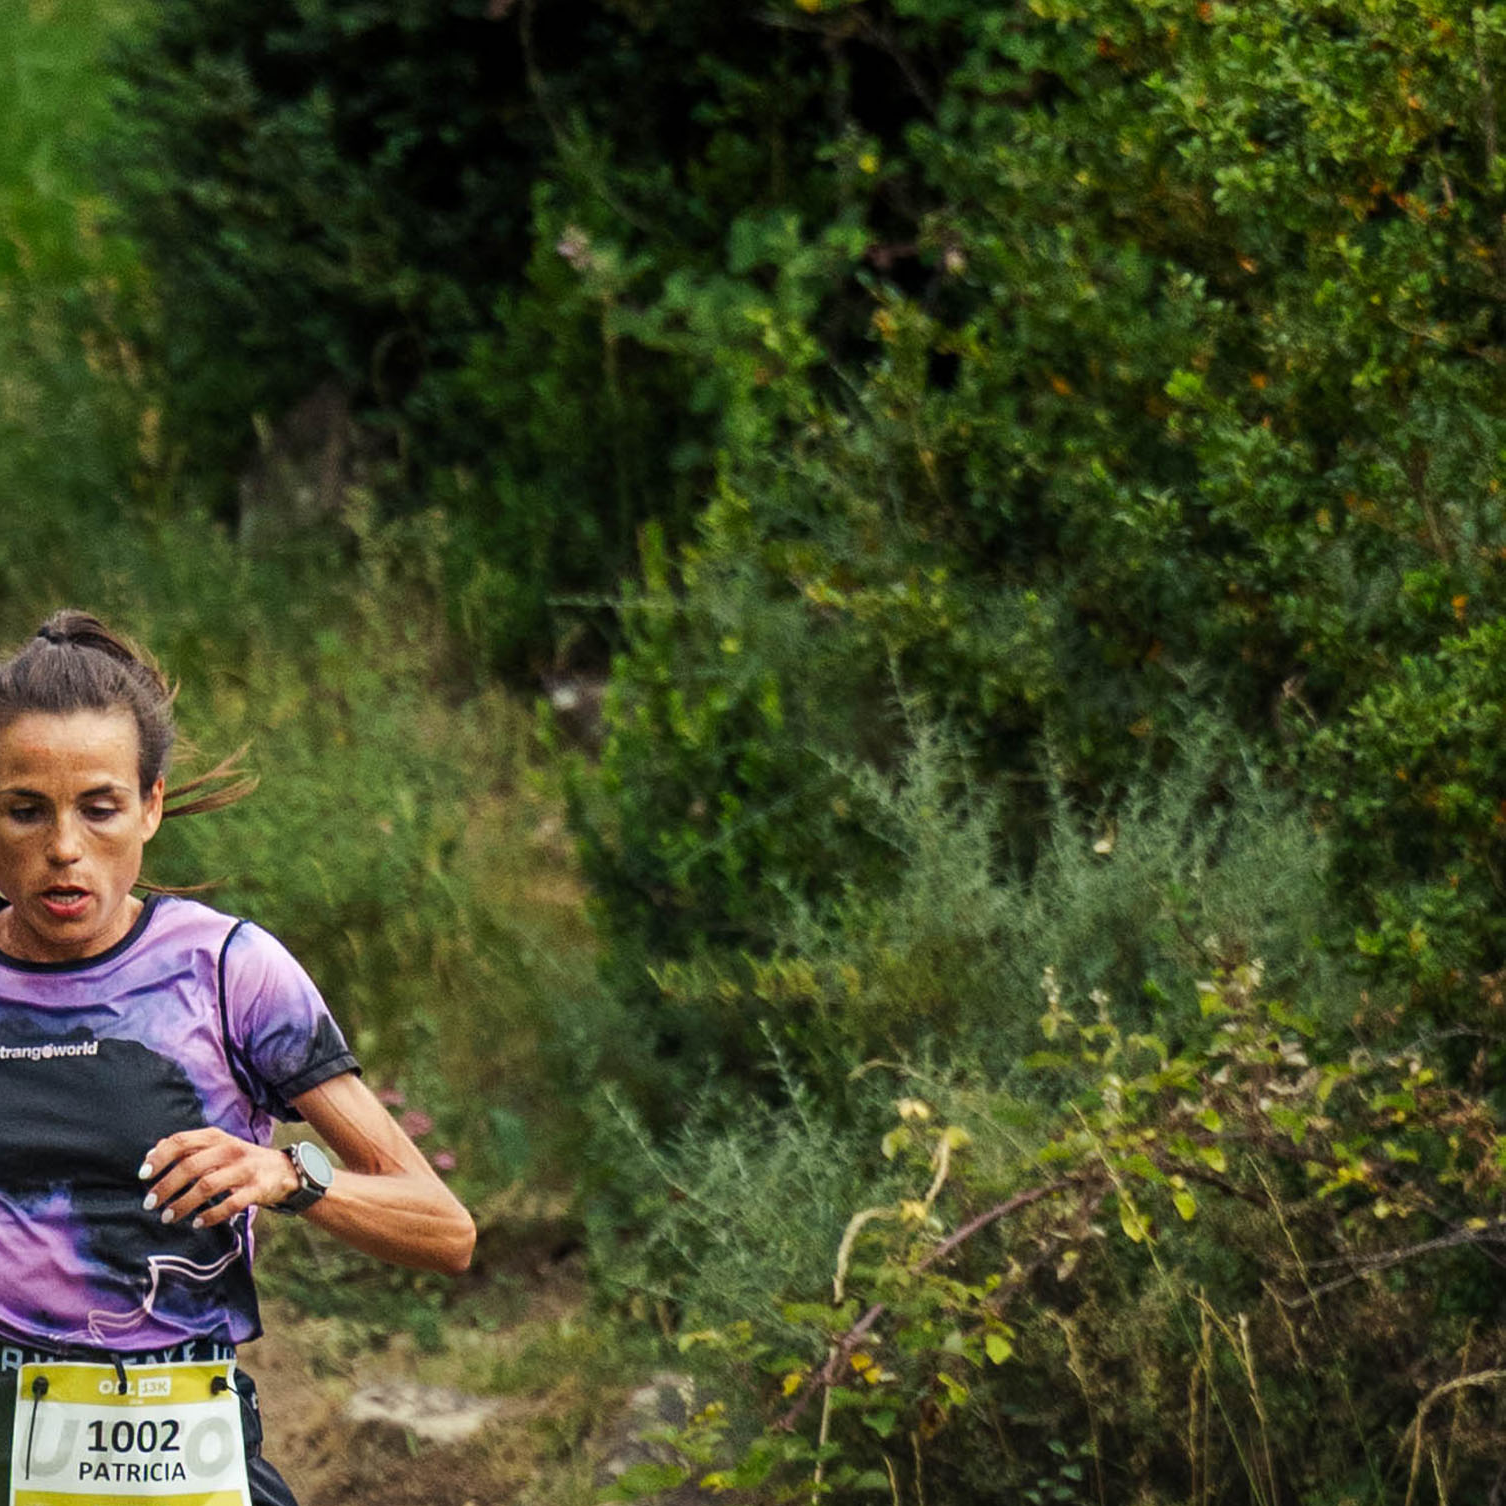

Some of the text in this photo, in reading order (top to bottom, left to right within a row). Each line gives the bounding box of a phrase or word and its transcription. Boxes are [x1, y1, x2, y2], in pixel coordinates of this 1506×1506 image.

[0, 1041, 99, 1061] trangoworld
[87, 1419, 181, 1454] 1002
[79, 1461, 187, 1482] PATRICIA
